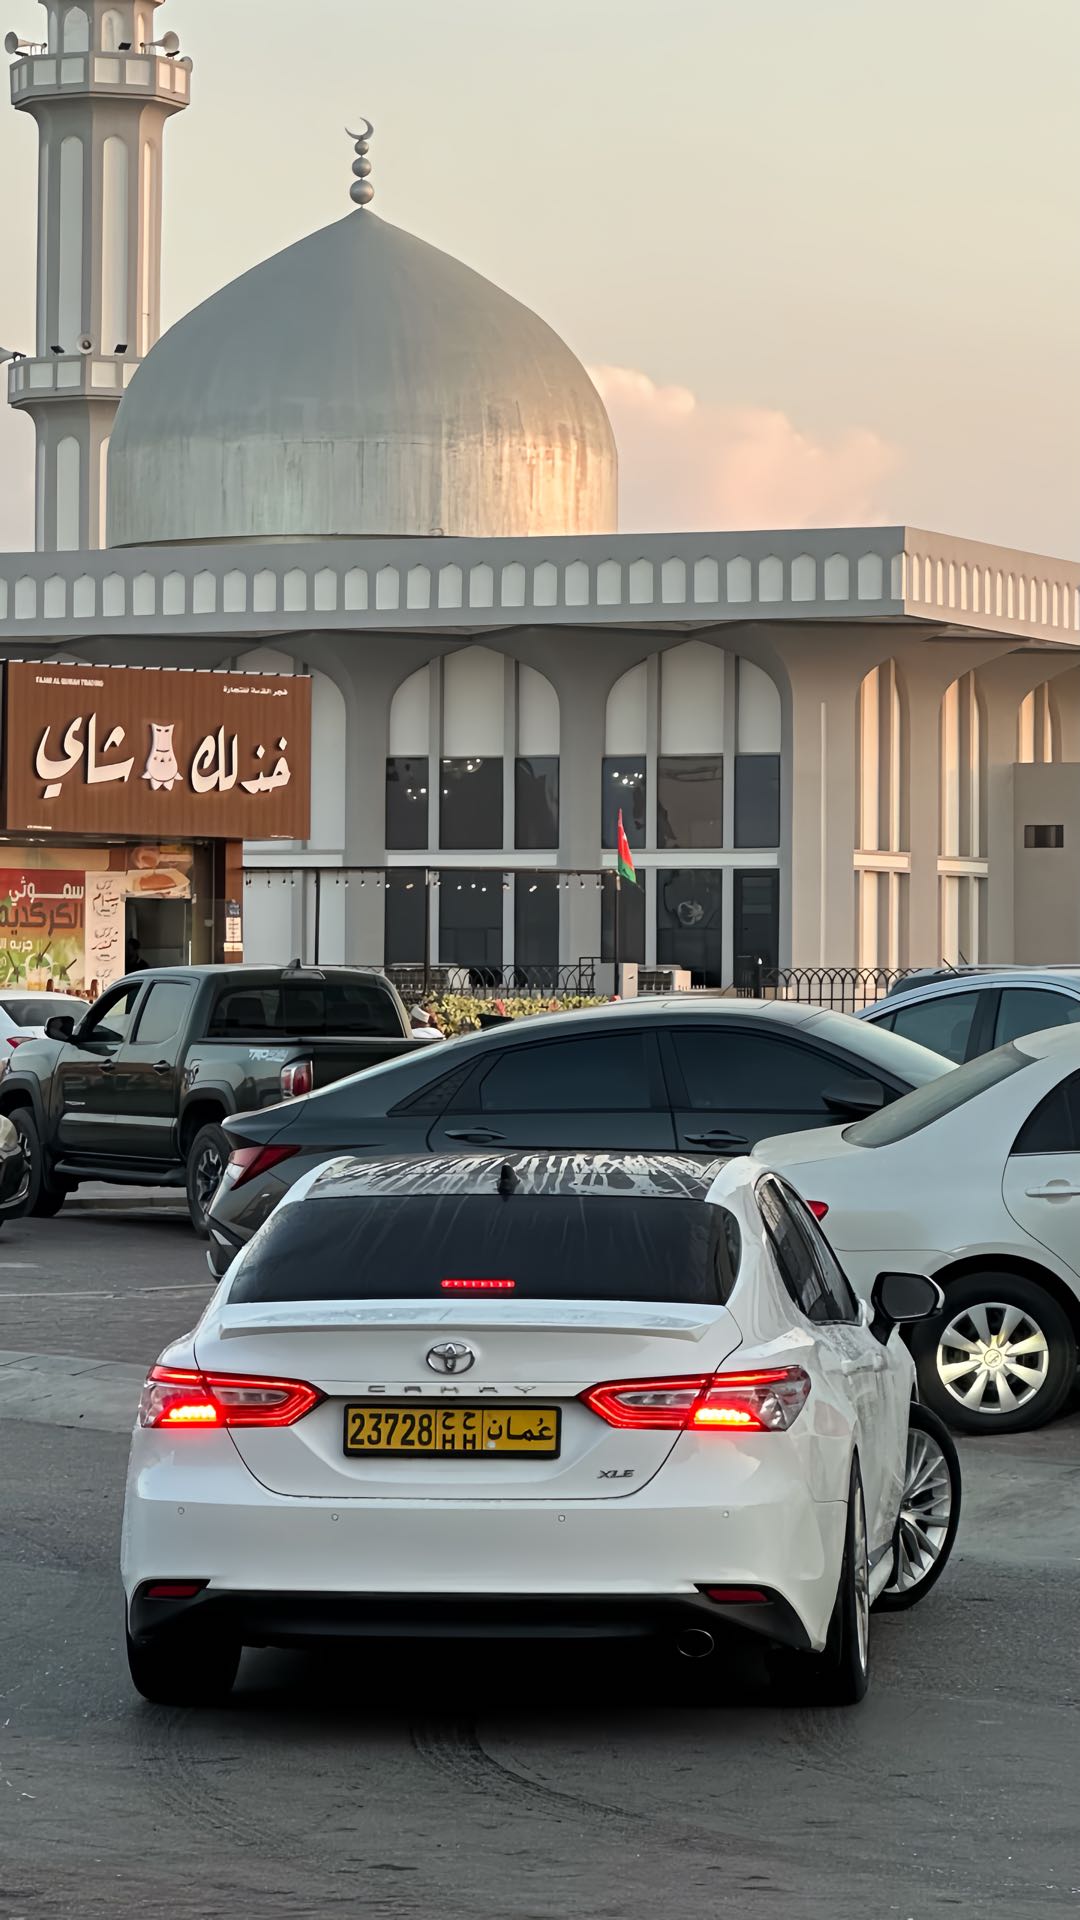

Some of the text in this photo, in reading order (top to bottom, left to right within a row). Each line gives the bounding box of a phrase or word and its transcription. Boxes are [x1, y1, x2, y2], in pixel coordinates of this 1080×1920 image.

[35, 712, 135, 799] شاي
[368, 1384, 536, 1394] CAMRY
[350, 1413, 433, 1446] 23728
[597, 1469, 635, 1479] XLE
